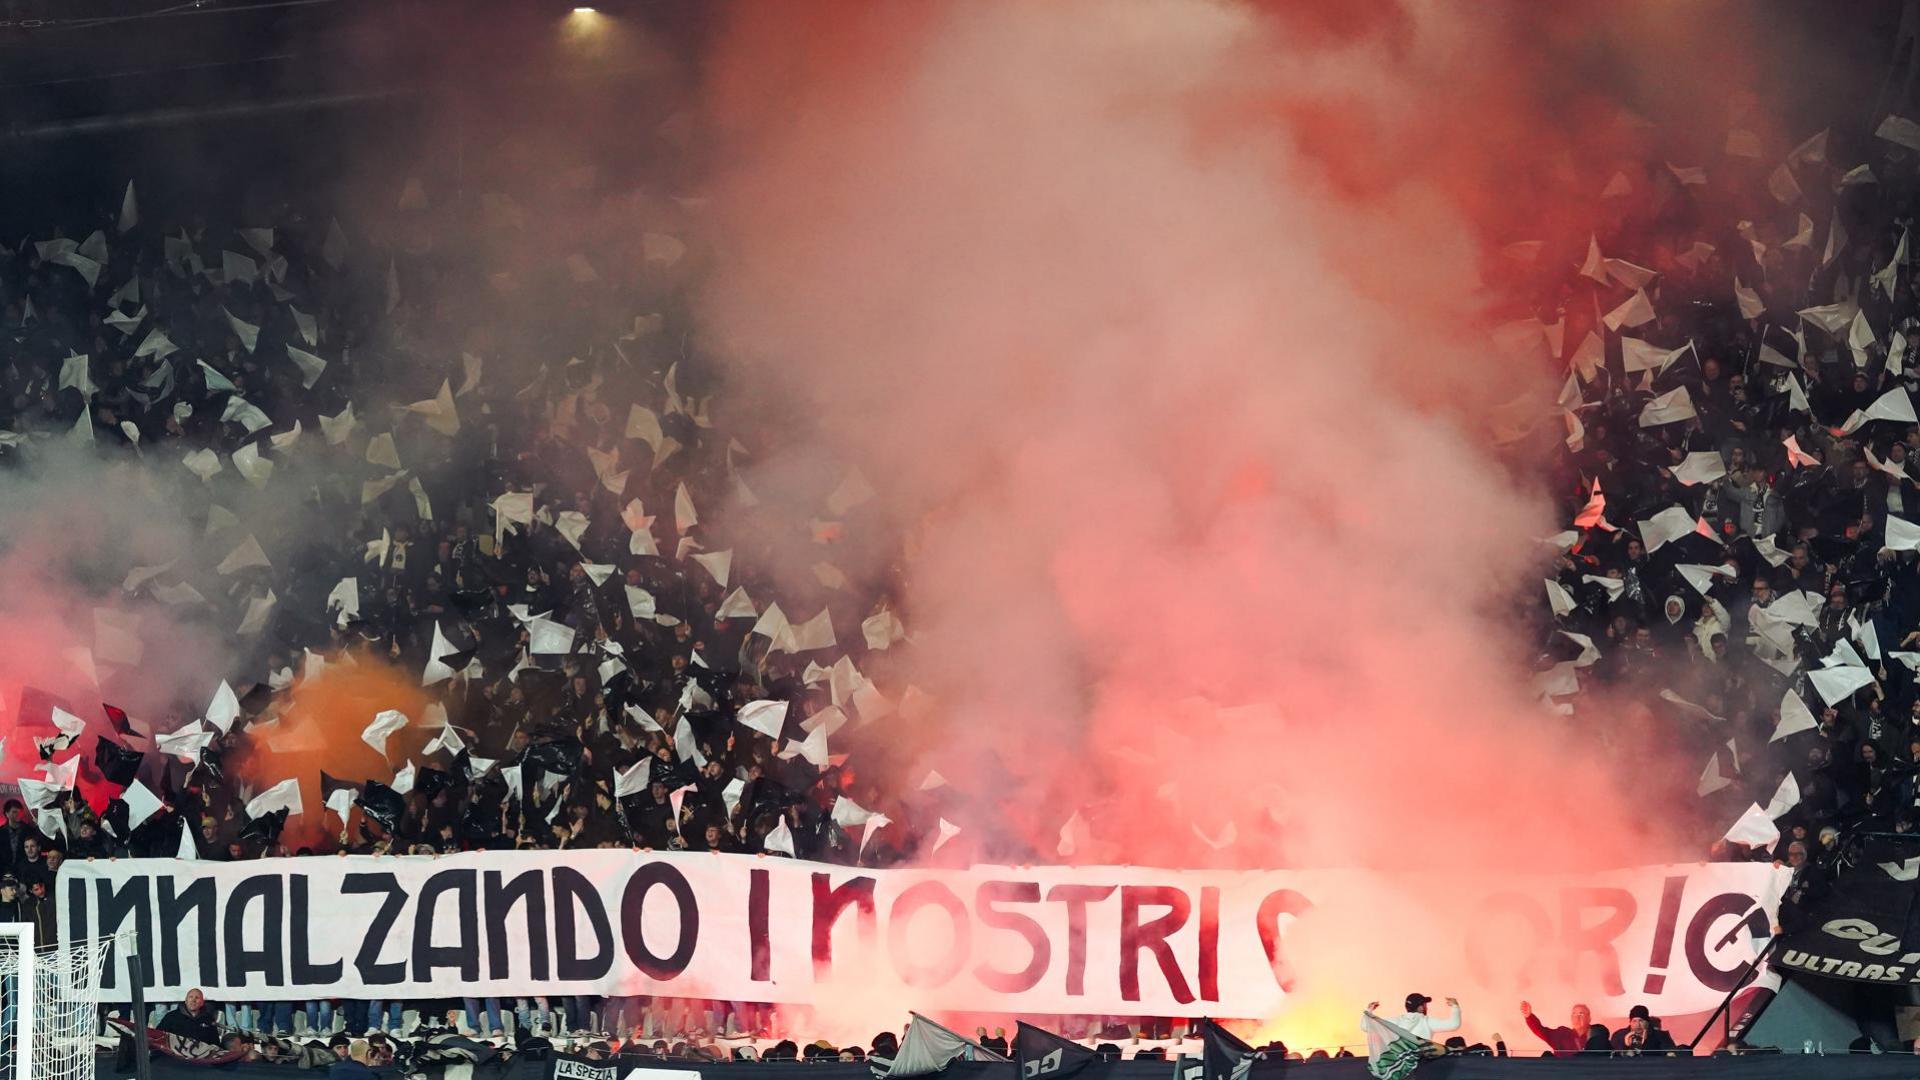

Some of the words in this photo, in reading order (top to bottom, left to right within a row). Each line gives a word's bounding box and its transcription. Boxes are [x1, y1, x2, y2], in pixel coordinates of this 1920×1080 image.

[750, 868, 771, 982] I
[1782, 949, 1906, 982] ULTRAS
[559, 1061, 573, 1075] LA
[576, 1064, 613, 1080] SPEZIA
